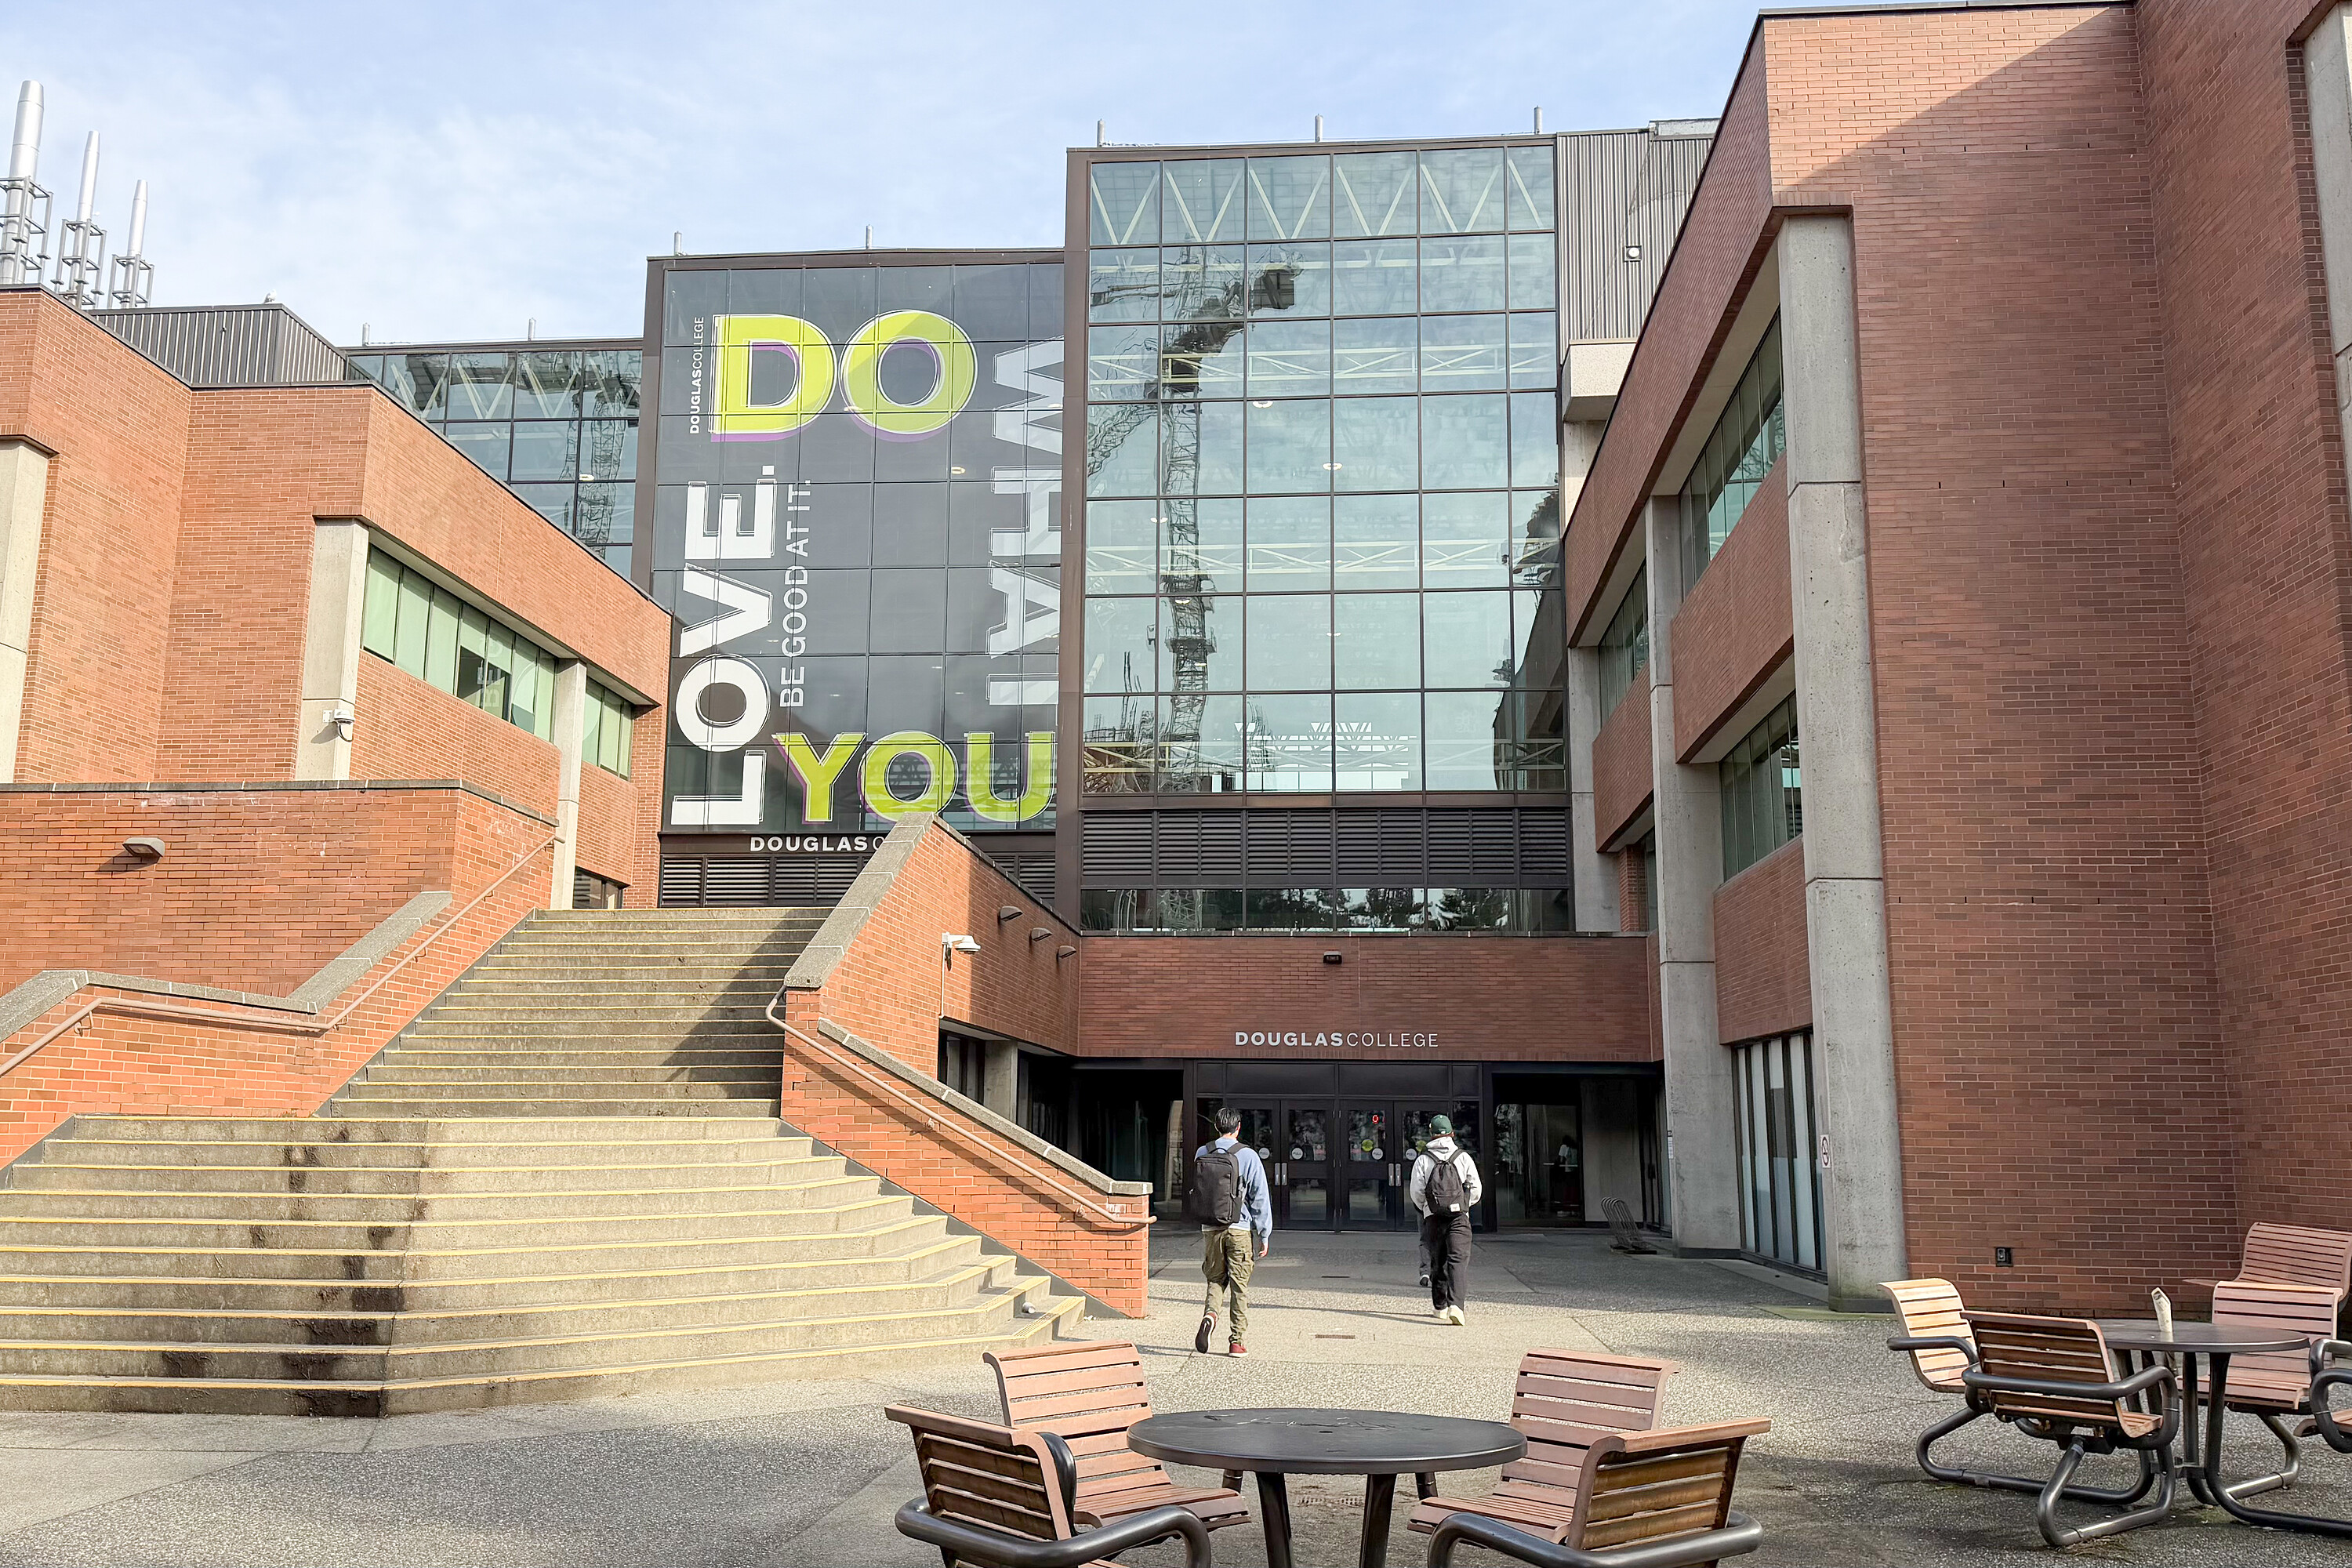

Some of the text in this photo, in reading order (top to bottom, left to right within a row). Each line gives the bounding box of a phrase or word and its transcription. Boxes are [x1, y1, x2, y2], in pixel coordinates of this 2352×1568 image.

[709, 310, 978, 441] DO
[671, 465, 776, 825] LOVE.
[779, 480, 811, 707] BE GOOD AT IT.
[771, 730, 1055, 824] YOU
